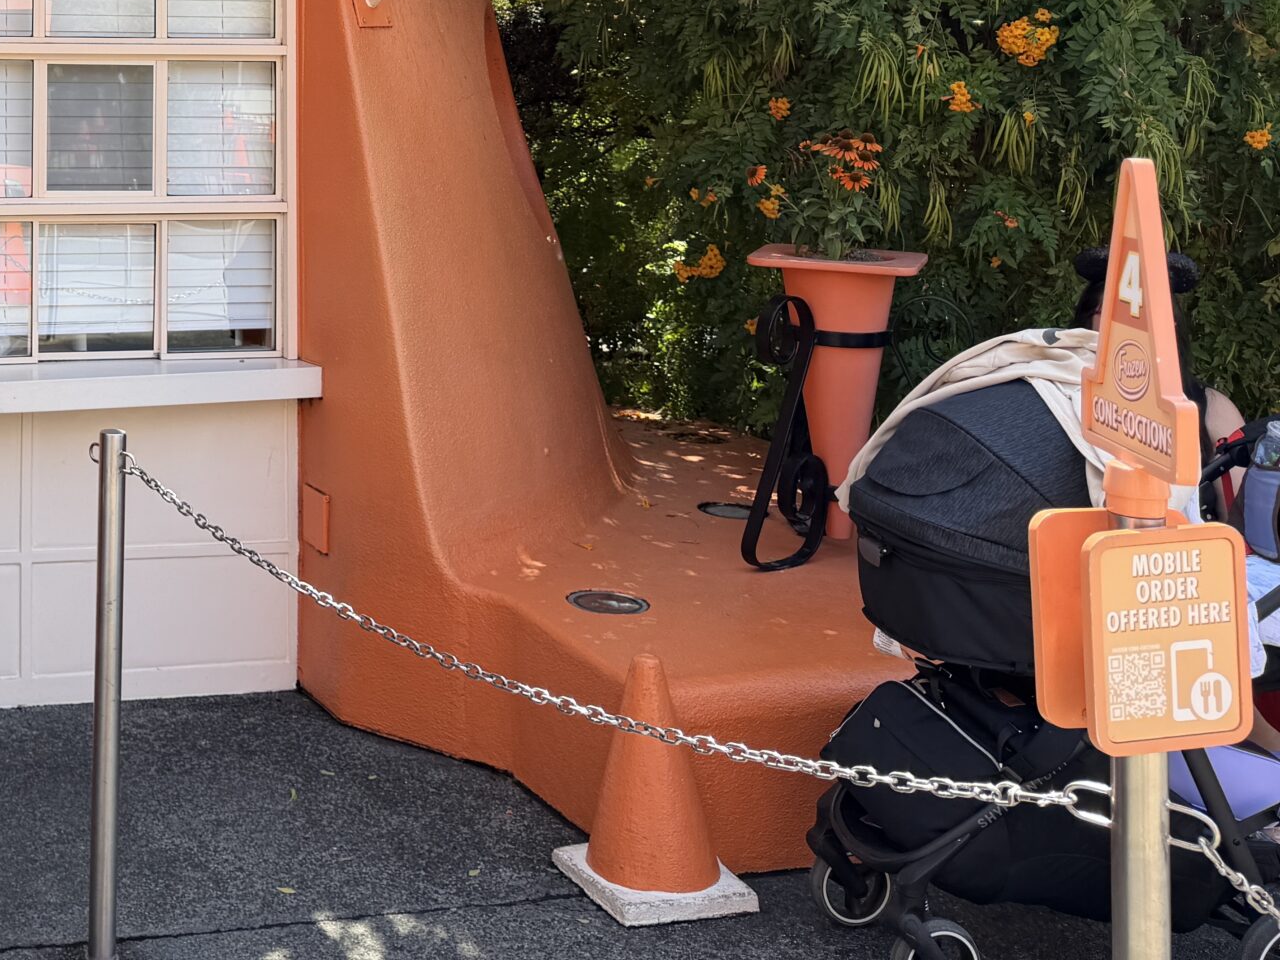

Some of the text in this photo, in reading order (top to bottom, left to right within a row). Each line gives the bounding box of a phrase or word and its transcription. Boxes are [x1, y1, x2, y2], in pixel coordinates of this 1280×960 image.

[1118, 250, 1144, 319] 4
[1118, 349, 1147, 381] Frozen
[1092, 395, 1173, 458] CONE-COCTIONS
[1132, 549, 1202, 577] MOBILE
[1135, 576, 1200, 604] ORDER
[1106, 601, 1232, 633] OFFERED HERE
